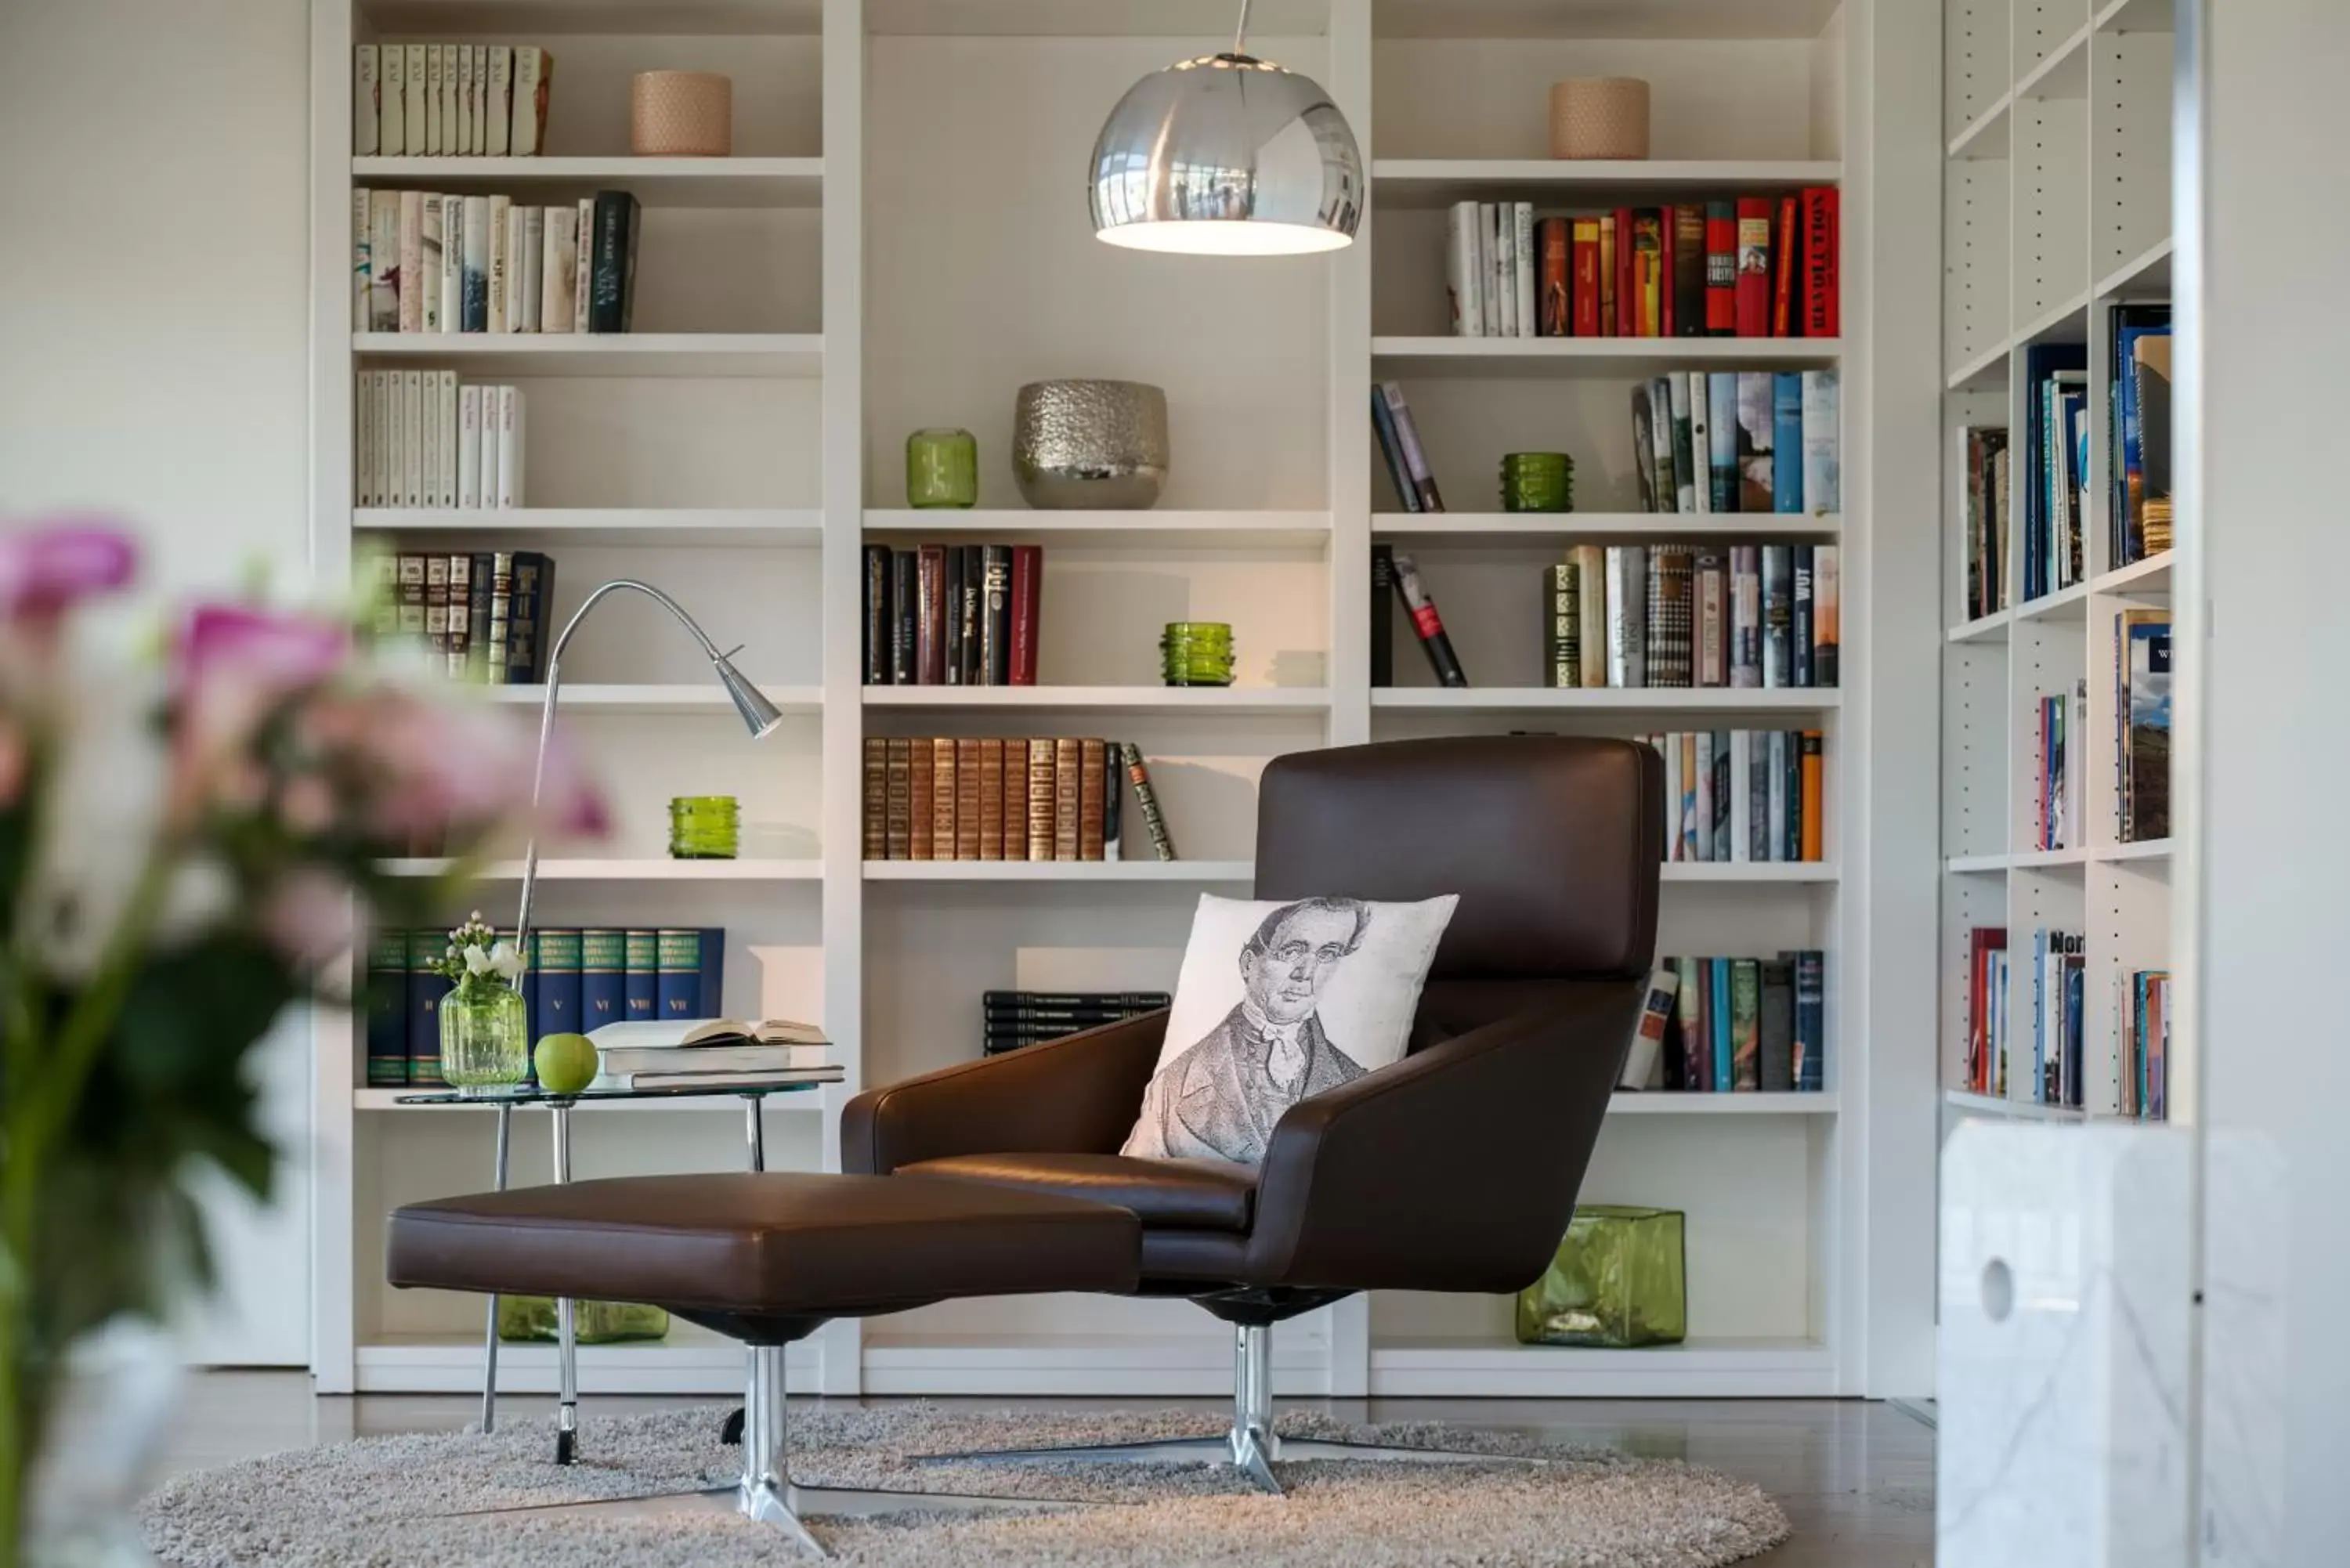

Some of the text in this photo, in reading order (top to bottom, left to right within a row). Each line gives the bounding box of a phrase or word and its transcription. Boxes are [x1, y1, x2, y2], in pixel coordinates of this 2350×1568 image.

[1811, 194, 1825, 329] REVOLUTION
[1795, 567, 1811, 602] WUT
[552, 999, 563, 1010] V
[595, 999, 609, 1011] VI
[629, 999, 650, 1010] VIII
[669, 999, 687, 1011] VII
